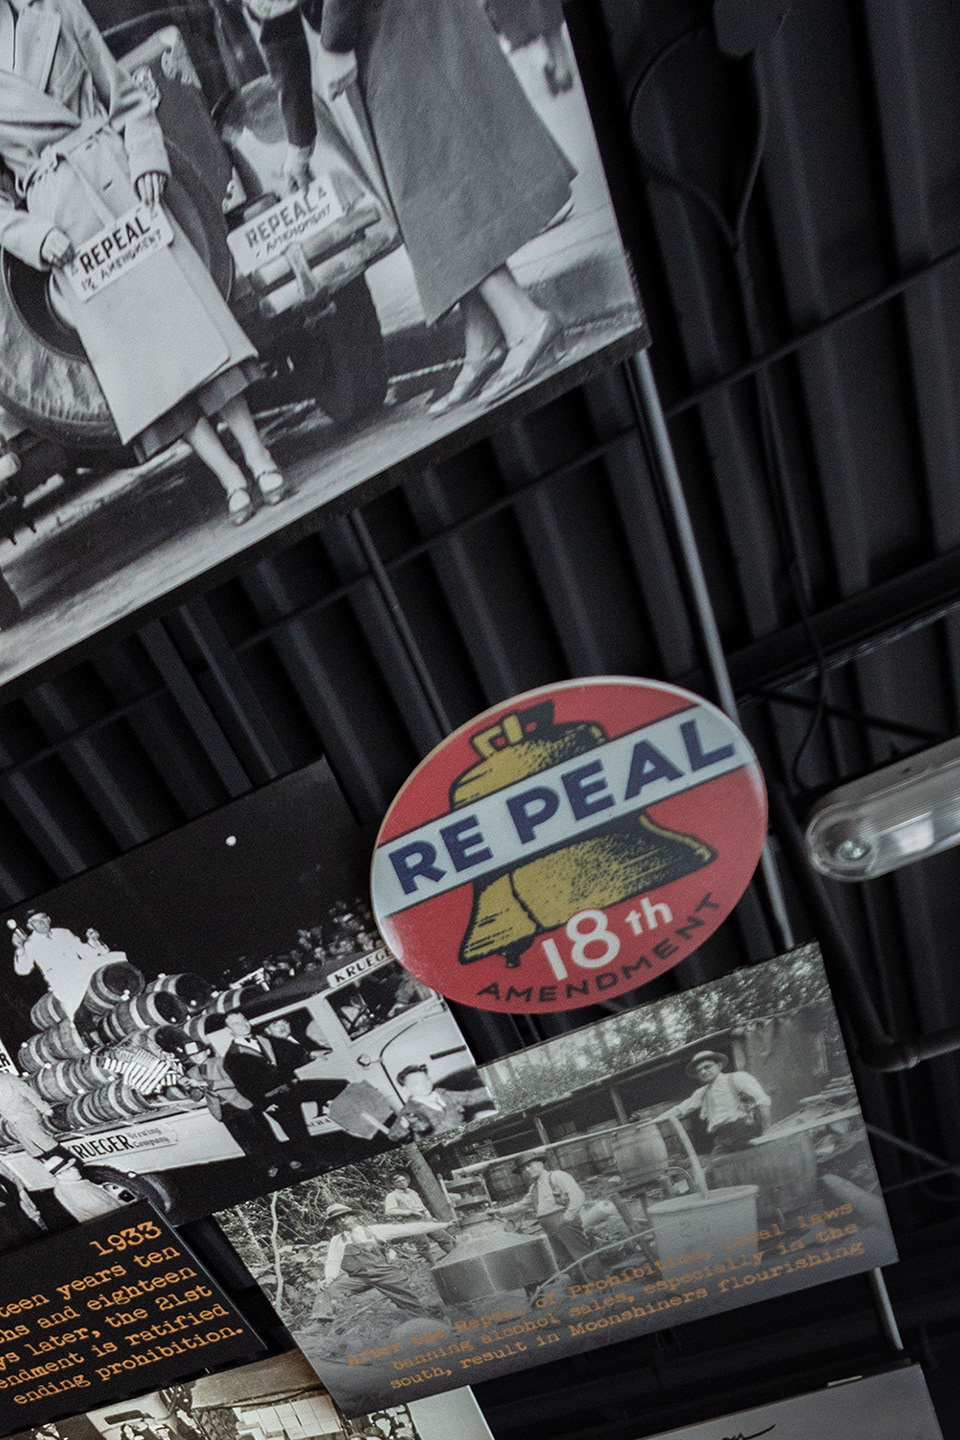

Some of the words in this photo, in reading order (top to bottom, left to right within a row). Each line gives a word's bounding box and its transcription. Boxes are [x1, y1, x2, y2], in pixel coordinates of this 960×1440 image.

[80, 216, 150, 273] REPEAL
[388, 718, 736, 895] REPEAL
[476, 892, 721, 1002] AMENDMENT
[541, 896, 674, 981] 18th
[69, 1134, 135, 1159] RUEGER
[57, 1261, 126, 1300] years
[134, 1245, 180, 1268] ten
[90, 1221, 162, 1256] 1933
[33, 1327, 100, 1356] later,
[105, 1307, 148, 1328] the
[156, 1284, 212, 1310] 21st
[38, 1306, 79, 1328] and
[87, 1265, 197, 1311] eighteen
[348, 1343, 401, 1367] After
[453, 1305, 525, 1333] Repeal
[568, 1250, 713, 1298] Prohibition,
[796, 1203, 853, 1230] laws
[390, 1367, 453, 1390] south,
[459, 1341, 528, 1370] result
[569, 1286, 709, 1338] Moonshiners
[718, 1241, 866, 1294] flourishing
[392, 1340, 474, 1371] banning
[481, 1314, 560, 1344] alcohol
[569, 1290, 635, 1318] sales,
[644, 1251, 766, 1295] especially
[13, 1374, 91, 1406] ending
[96, 1328, 243, 1381] prohibition.
[92, 1339, 117, 1356] is
[125, 1304, 229, 1345] ratified
